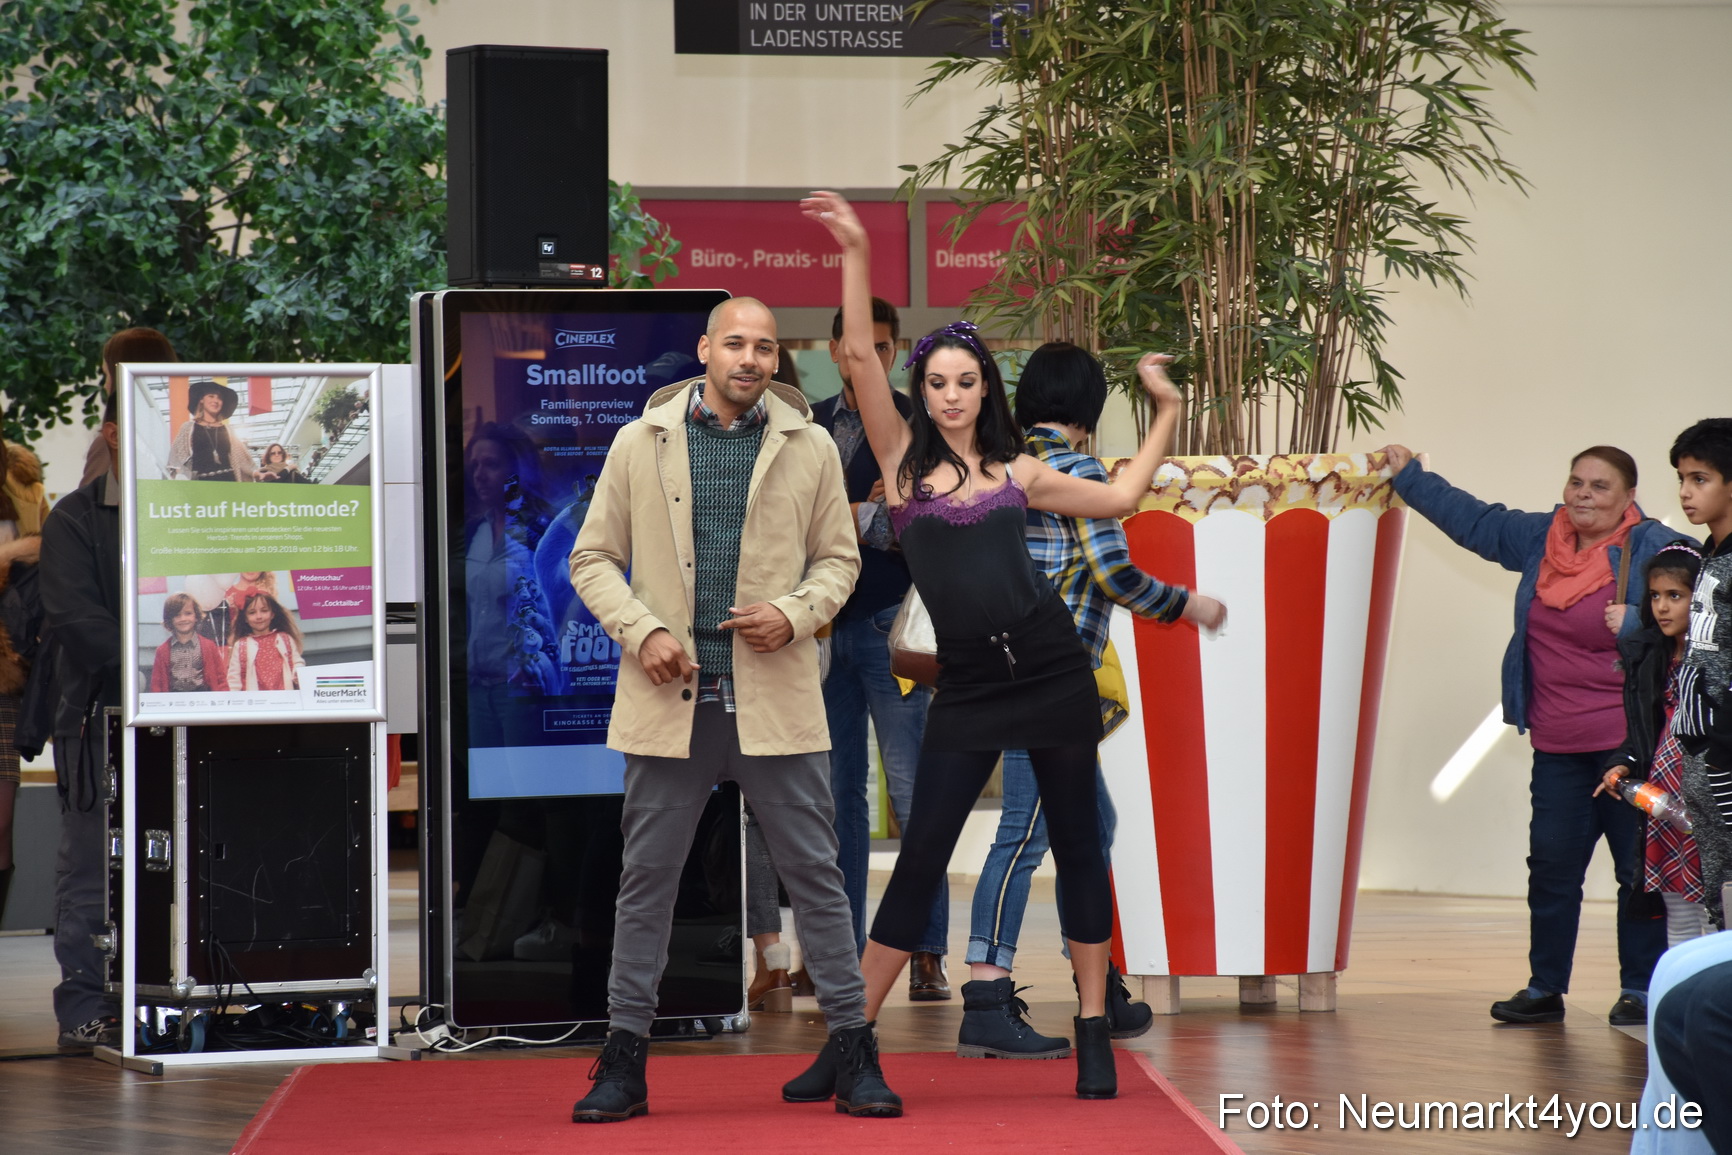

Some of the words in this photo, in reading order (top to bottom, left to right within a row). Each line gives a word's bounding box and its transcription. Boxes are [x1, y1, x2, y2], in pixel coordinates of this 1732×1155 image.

[750, 3, 767, 20] IN
[774, 3, 806, 21] DER
[815, 4, 904, 22] UNTEREN
[751, 29, 904, 48] LADENSTRASSE
[691, 249, 749, 269] Büro-,
[753, 250, 818, 268] Praxis-
[822, 254, 845, 268] un
[590, 267, 603, 278] 12
[526, 364, 647, 385] Smallfoot
[541, 399, 634, 411] Familienpreview
[531, 414, 582, 426] Sonntag,
[585, 414, 594, 424] 7.
[597, 413, 641, 424] Oktobe
[149, 502, 192, 519] Lust
[195, 501, 228, 518] auf
[232, 500, 360, 518] Herbstmode?
[256, 545, 298, 553] 29.09.2018
[566, 620, 605, 638] SMA
[313, 689, 367, 697] NeuerMarkt
